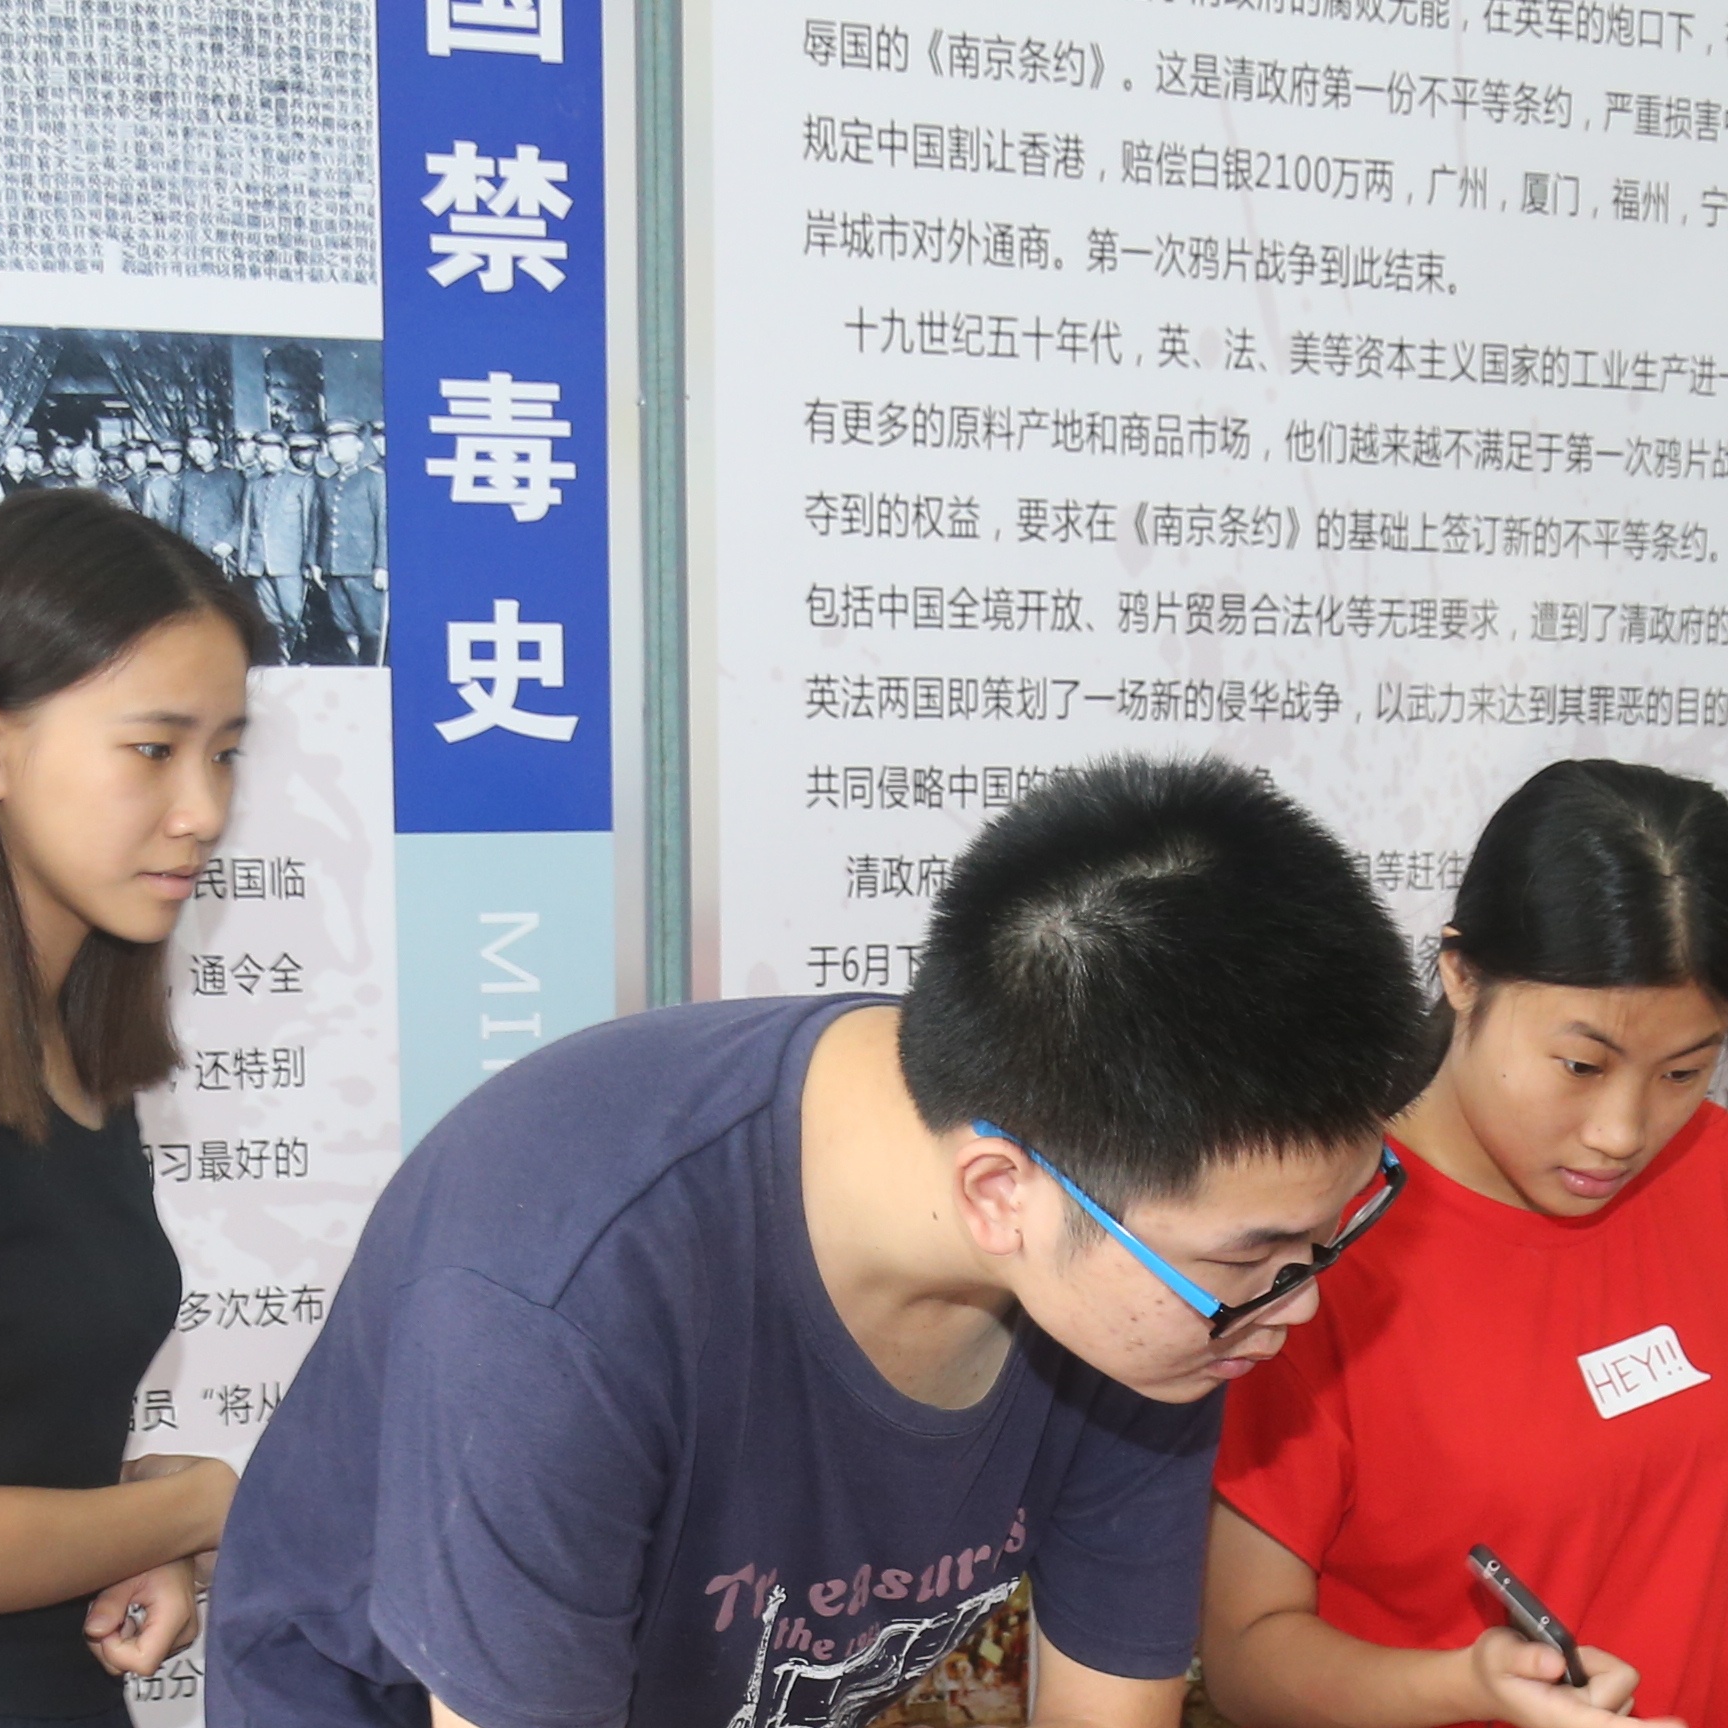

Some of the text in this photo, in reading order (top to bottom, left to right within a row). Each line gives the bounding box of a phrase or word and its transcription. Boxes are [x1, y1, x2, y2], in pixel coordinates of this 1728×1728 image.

[803, 210, 1458, 297] 岸城市对外通商。第一次鸦片战争到此结束。
[479, 911, 542, 1070] MI
[1586, 1337, 1686, 1406] HEY!!
